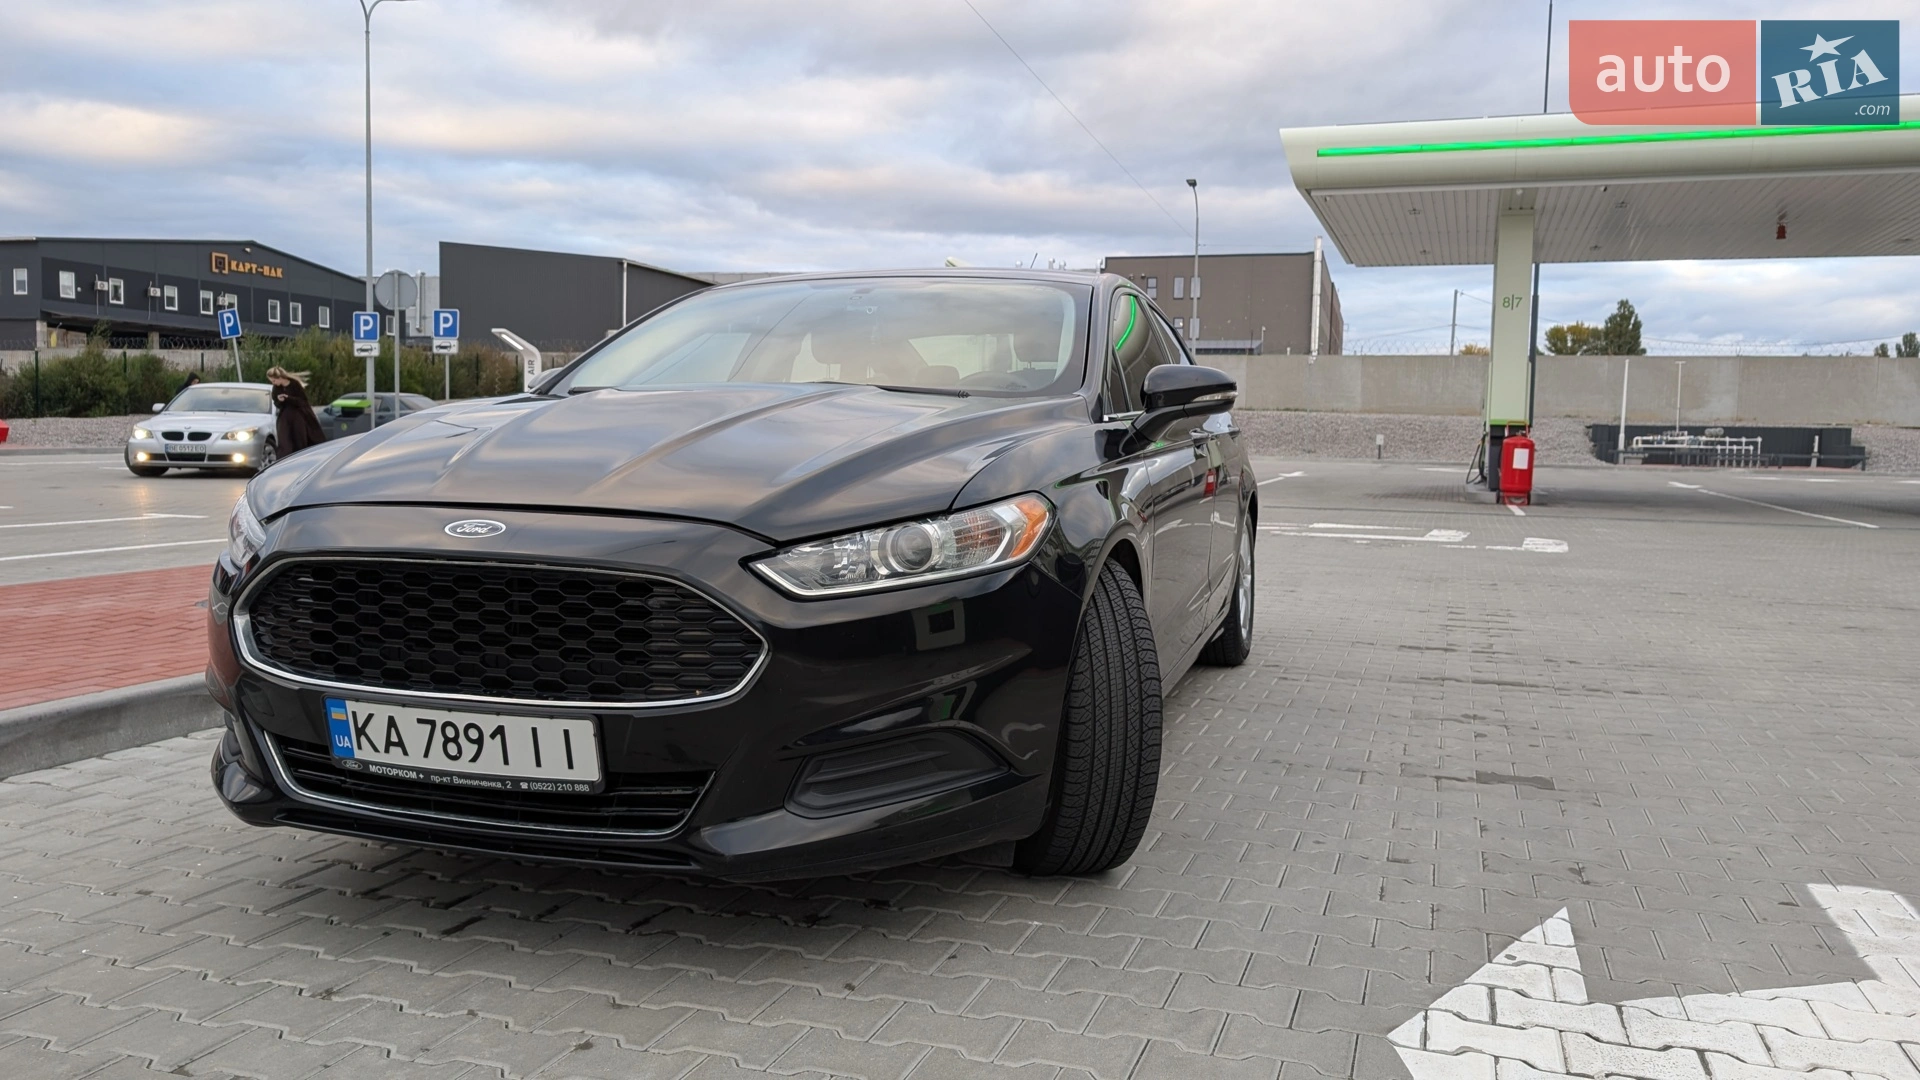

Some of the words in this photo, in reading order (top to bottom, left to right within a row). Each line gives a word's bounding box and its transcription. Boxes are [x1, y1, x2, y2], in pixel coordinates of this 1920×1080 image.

[230, 259, 283, 278] КАРТ-ПАК
[223, 312, 235, 336] P
[359, 314, 374, 339] P
[439, 312, 454, 336] P
[528, 359, 536, 375] AIR
[456, 522, 493, 534] Ford
[335, 734, 352, 749] UA
[369, 764, 417, 779] МОТОРКОМ
[430, 775, 451, 784] пр-кт
[506, 780, 512, 789] 2
[530, 781, 556, 791] (0522)
[557, 783, 573, 791] 210
[574, 783, 590, 792] 888
